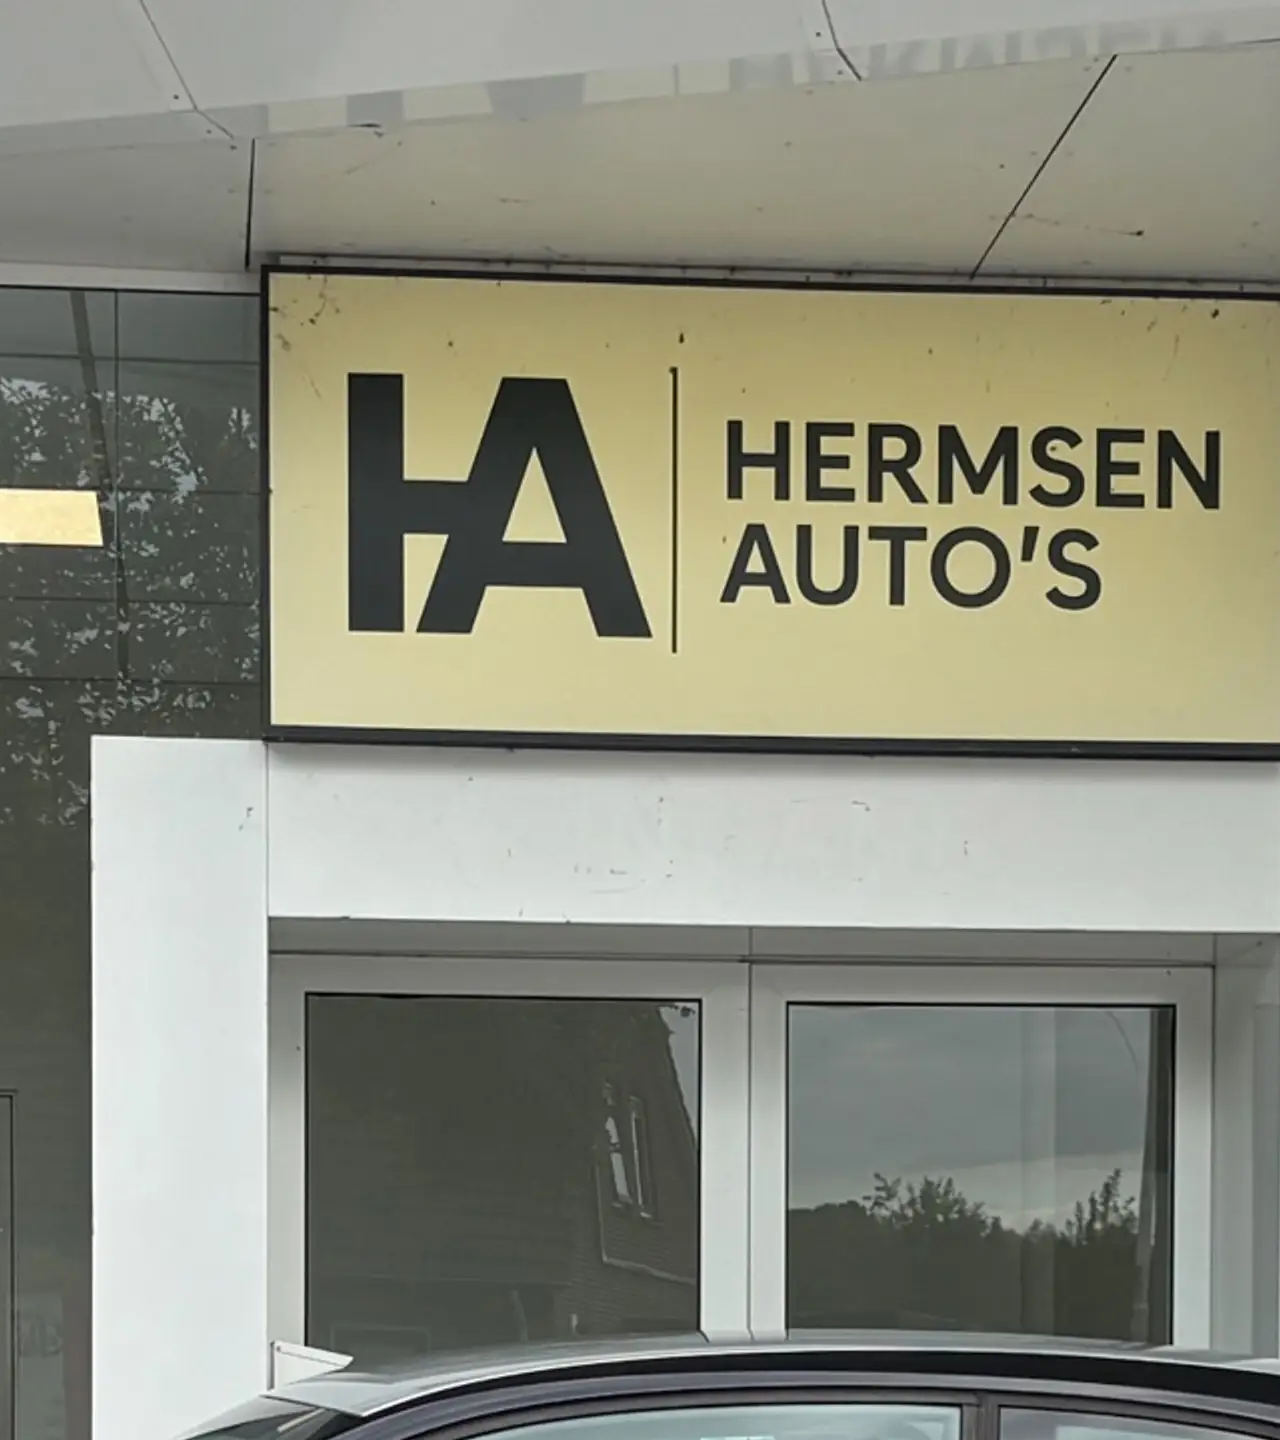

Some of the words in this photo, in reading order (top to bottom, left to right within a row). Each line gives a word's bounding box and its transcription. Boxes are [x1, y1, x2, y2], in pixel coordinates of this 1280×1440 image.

[348, 373, 652, 638] HA
[727, 420, 1221, 510] HERMSEN
[720, 523, 1101, 610] AUTO'S
